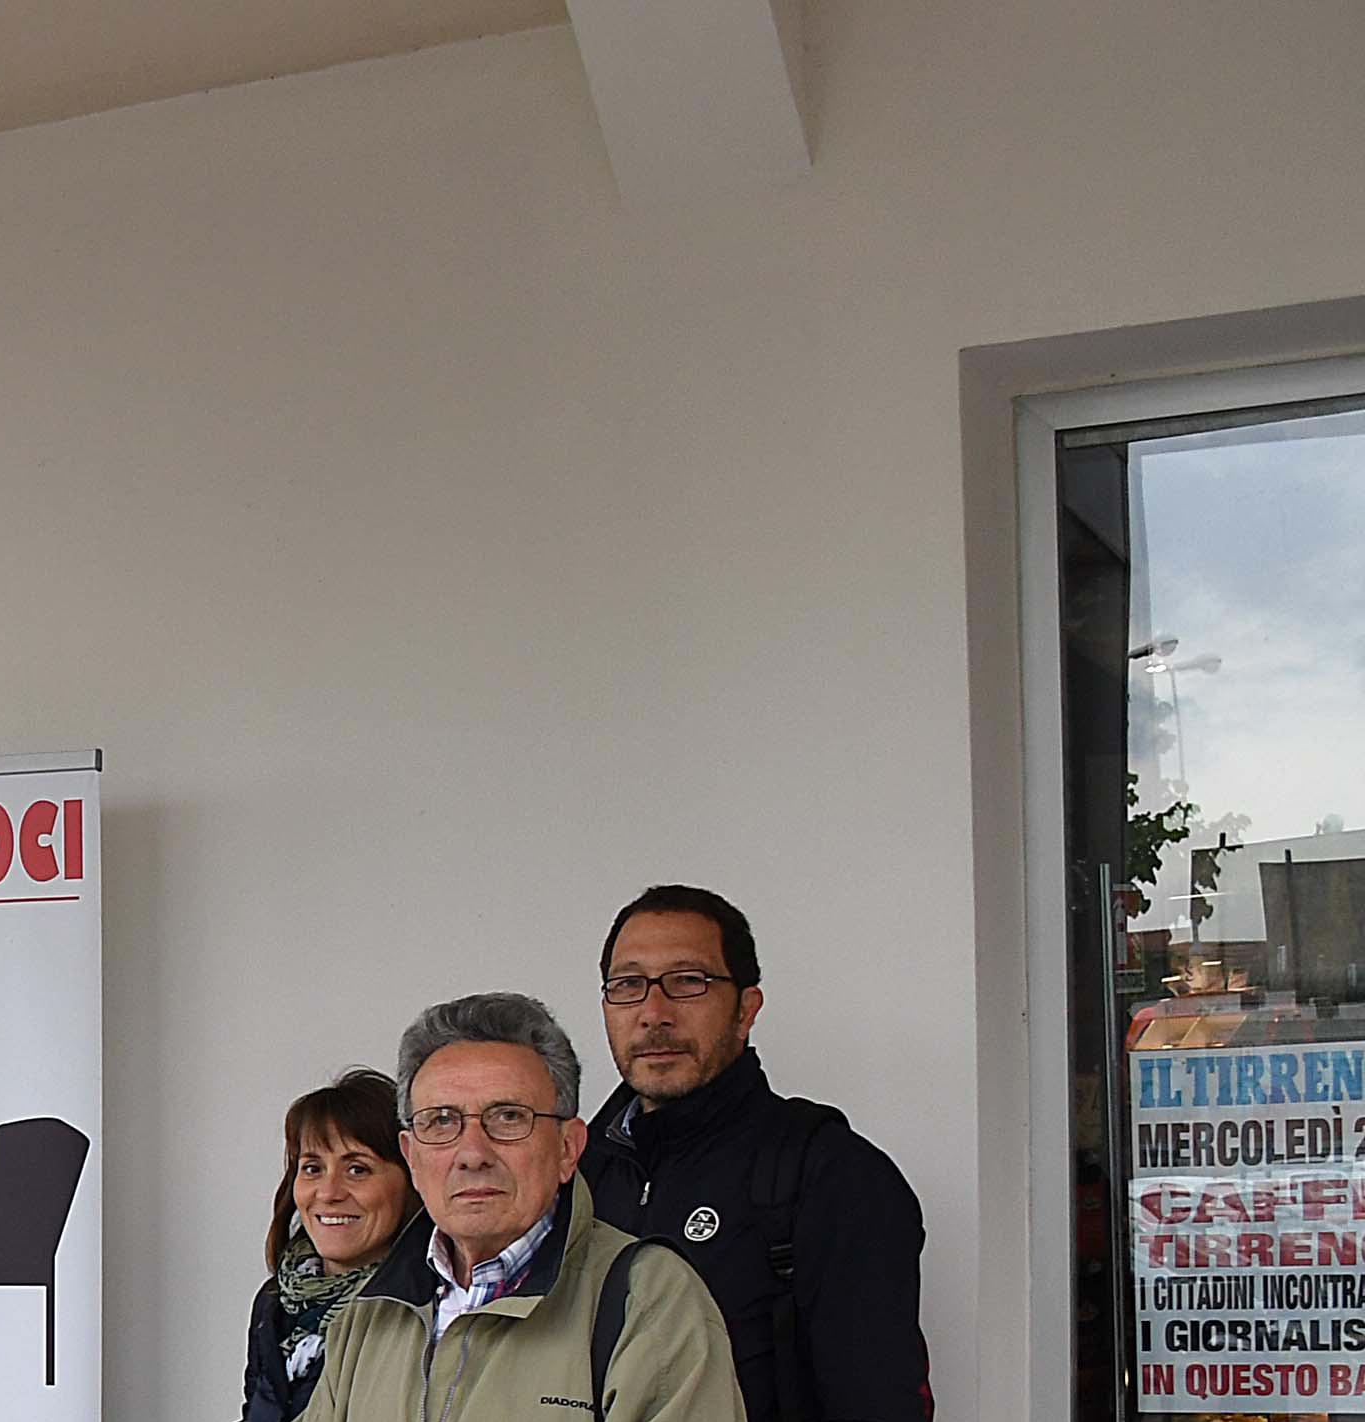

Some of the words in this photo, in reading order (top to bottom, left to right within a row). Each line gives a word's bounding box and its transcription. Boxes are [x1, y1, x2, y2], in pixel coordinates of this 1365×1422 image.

[1138, 1058, 1182, 1108] IL
[1186, 1050, 1365, 1107] TIRREN
[1138, 1106, 1343, 1168] MERCOLEDÌ
[1140, 1178, 1365, 1225] CAFF
[1140, 1232, 1365, 1268] TIRREN
[1140, 1277, 1147, 1310] I
[1154, 1275, 1255, 1311] CITTADINI
[1141, 1320, 1151, 1352] I
[1165, 1319, 1365, 1352] GIORNALIS
[1142, 1364, 1175, 1396] IN
[1185, 1363, 1318, 1400] QUESTO
